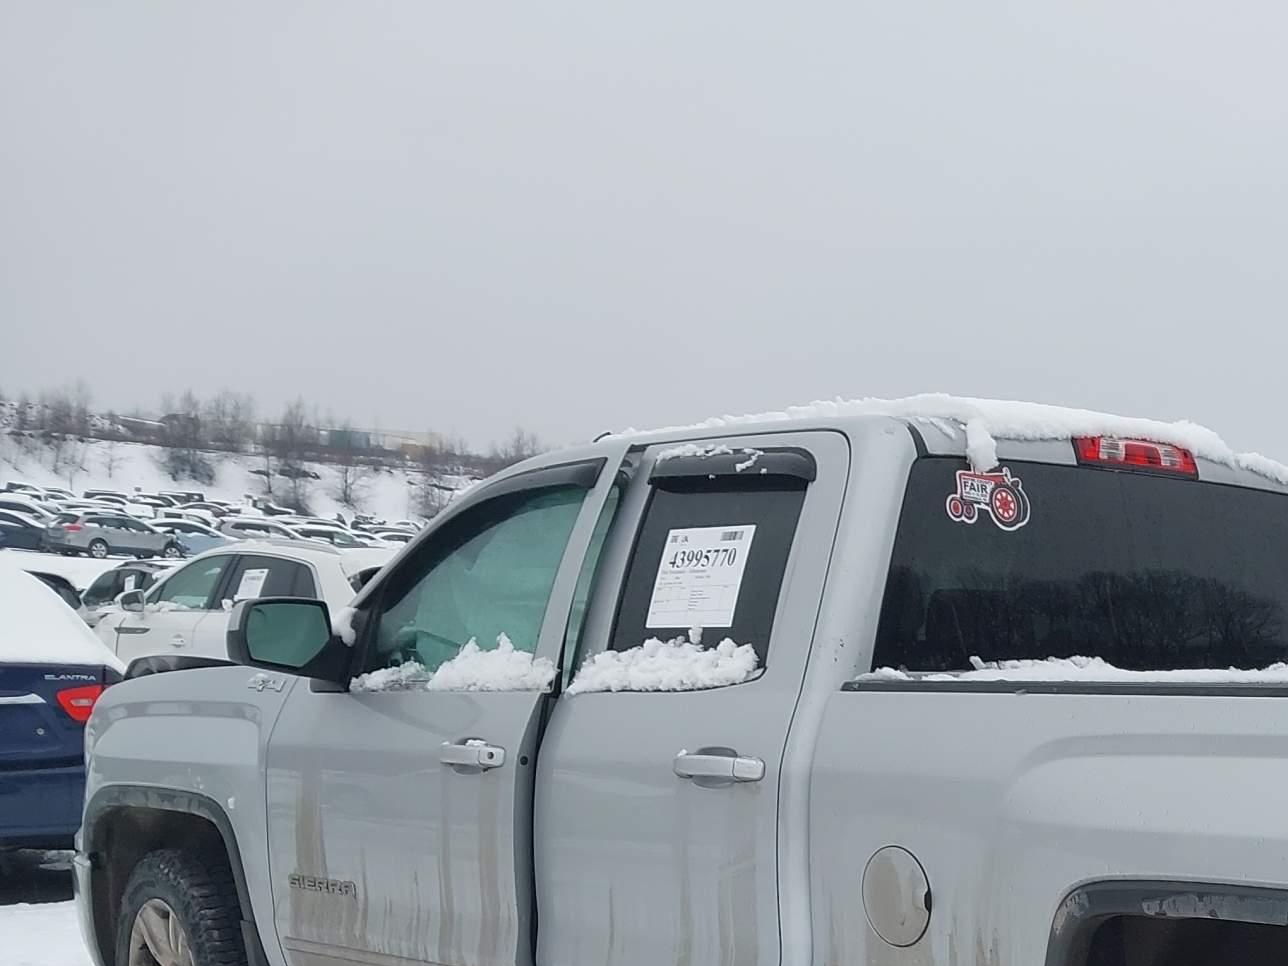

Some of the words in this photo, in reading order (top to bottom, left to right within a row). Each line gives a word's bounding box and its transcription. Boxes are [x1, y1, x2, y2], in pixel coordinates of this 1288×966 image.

[963, 481, 988, 494] FAIR
[669, 548, 737, 568] 43995770
[288, 873, 357, 899] SIERRA
